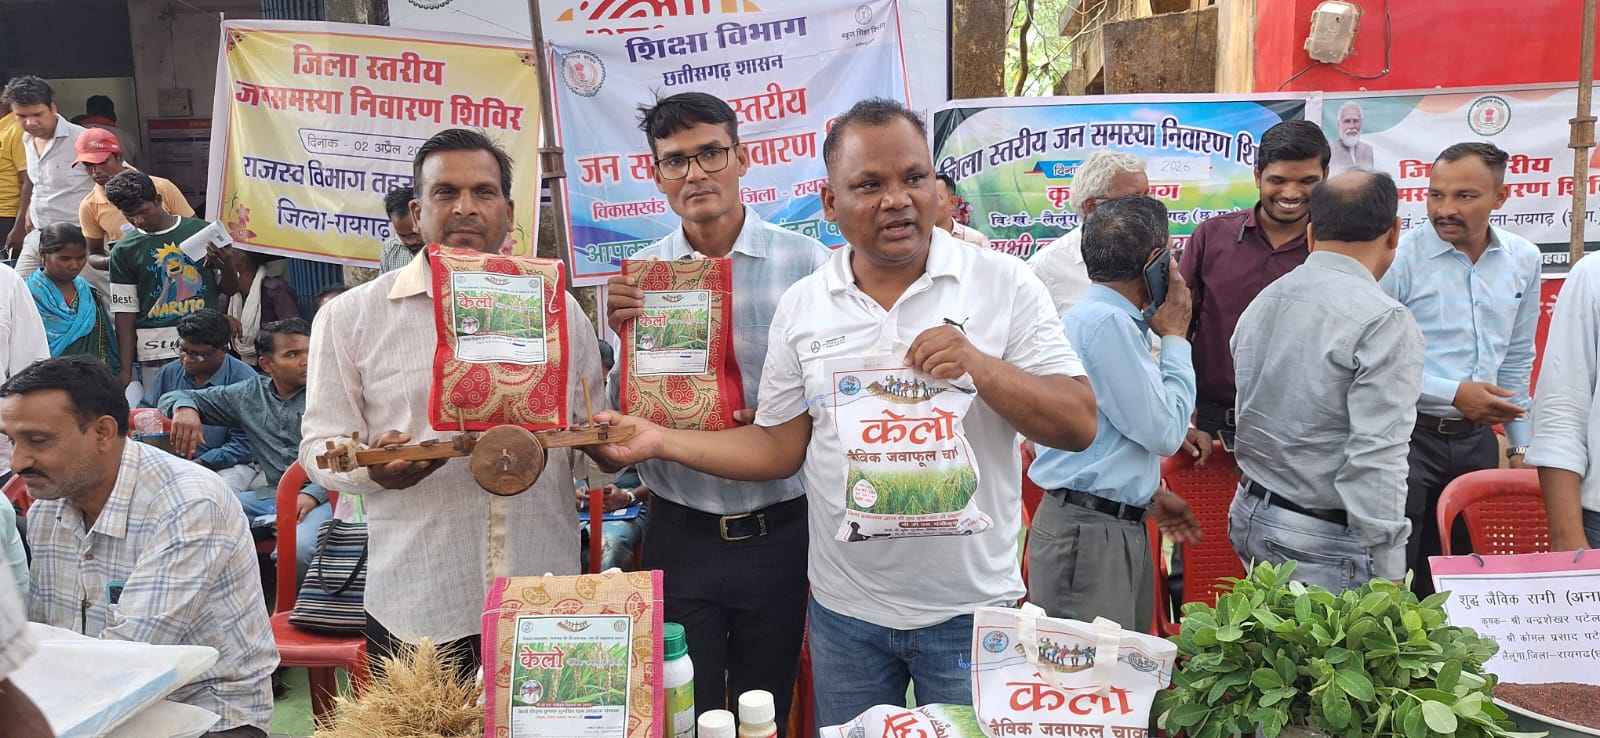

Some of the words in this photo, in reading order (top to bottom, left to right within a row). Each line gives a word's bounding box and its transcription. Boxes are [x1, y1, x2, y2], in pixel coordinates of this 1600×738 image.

[625, 32, 708, 63] शिक्षा
[715, 16, 807, 49] विभाग
[293, 44, 359, 79] जिला
[366, 52, 446, 86] स्तरीय
[662, 63, 731, 87] छत्तीसगढ़
[735, 54, 784, 76] शासन
[349, 86, 444, 124] निवारण
[450, 94, 524, 131] शिविर
[307, 133, 339, 149] दिनांक
[354, 141, 369, 152] 02
[375, 139, 401, 155] अप्रैल
[989, 128, 1047, 167] स्तरीय
[1053, 125, 1086, 150] जन
[1091, 123, 1155, 147] समस्या
[1162, 117, 1232, 159] निवारण
[242, 156, 304, 185] राजस्व
[308, 159, 366, 192] विभाग
[578, 155, 620, 184] जन
[740, 186, 777, 204] जिला
[276, 197, 391, 242] जिला-रायगढ़
[592, 198, 667, 220] विकासखंड
[112, 294, 133, 304] Best
[147, 298, 206, 319] NARUTO
[457, 292, 493, 309] केलो
[639, 313, 668, 328] केलो
[859, 406, 958, 445] केलो
[886, 450, 937, 468] जवाफूल
[1458, 594, 1480, 610] शुद्ध
[1485, 590, 1520, 606] जैविक
[1525, 589, 1557, 604] रागी
[1511, 614, 1521, 625] श्री
[1506, 632, 1516, 643] श्री
[1520, 631, 1545, 642] कोमल
[1551, 632, 1578, 642] प्रसाद
[519, 645, 565, 668] केलो
[1006, 672, 1134, 716] केलो
